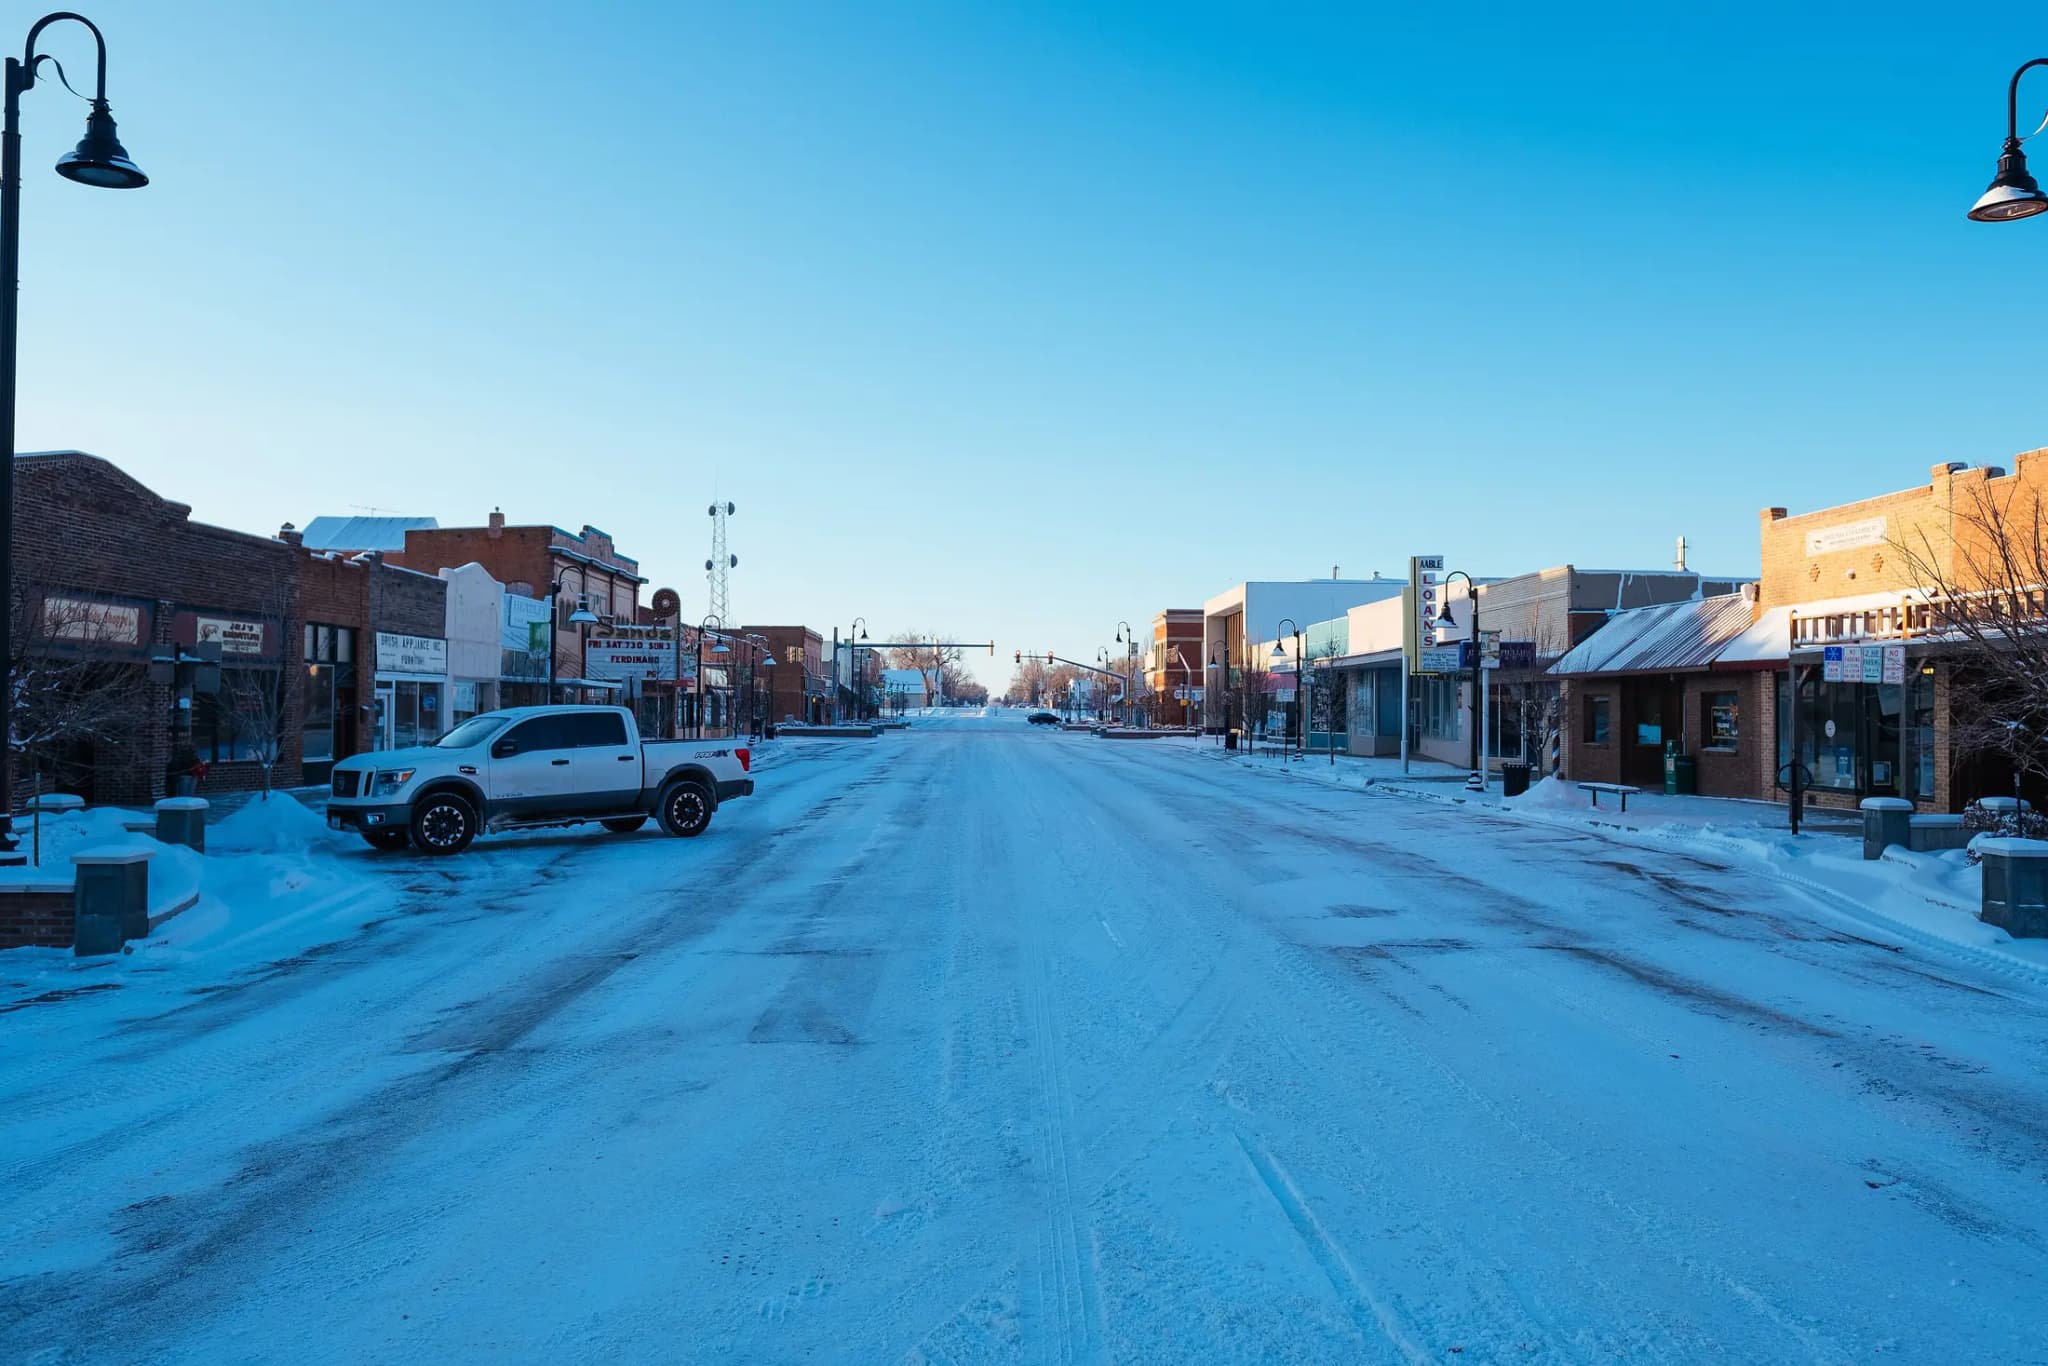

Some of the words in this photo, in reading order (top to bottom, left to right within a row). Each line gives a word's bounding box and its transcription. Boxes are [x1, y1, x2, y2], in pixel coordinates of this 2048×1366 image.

[1420, 559, 1443, 569] AABLE
[1422, 574, 1434, 647] LOANS
[588, 640, 602, 649] FRI
[606, 640, 622, 649] SAT
[649, 641, 664, 650] SUN
[610, 655, 659, 664] FERDINAND
